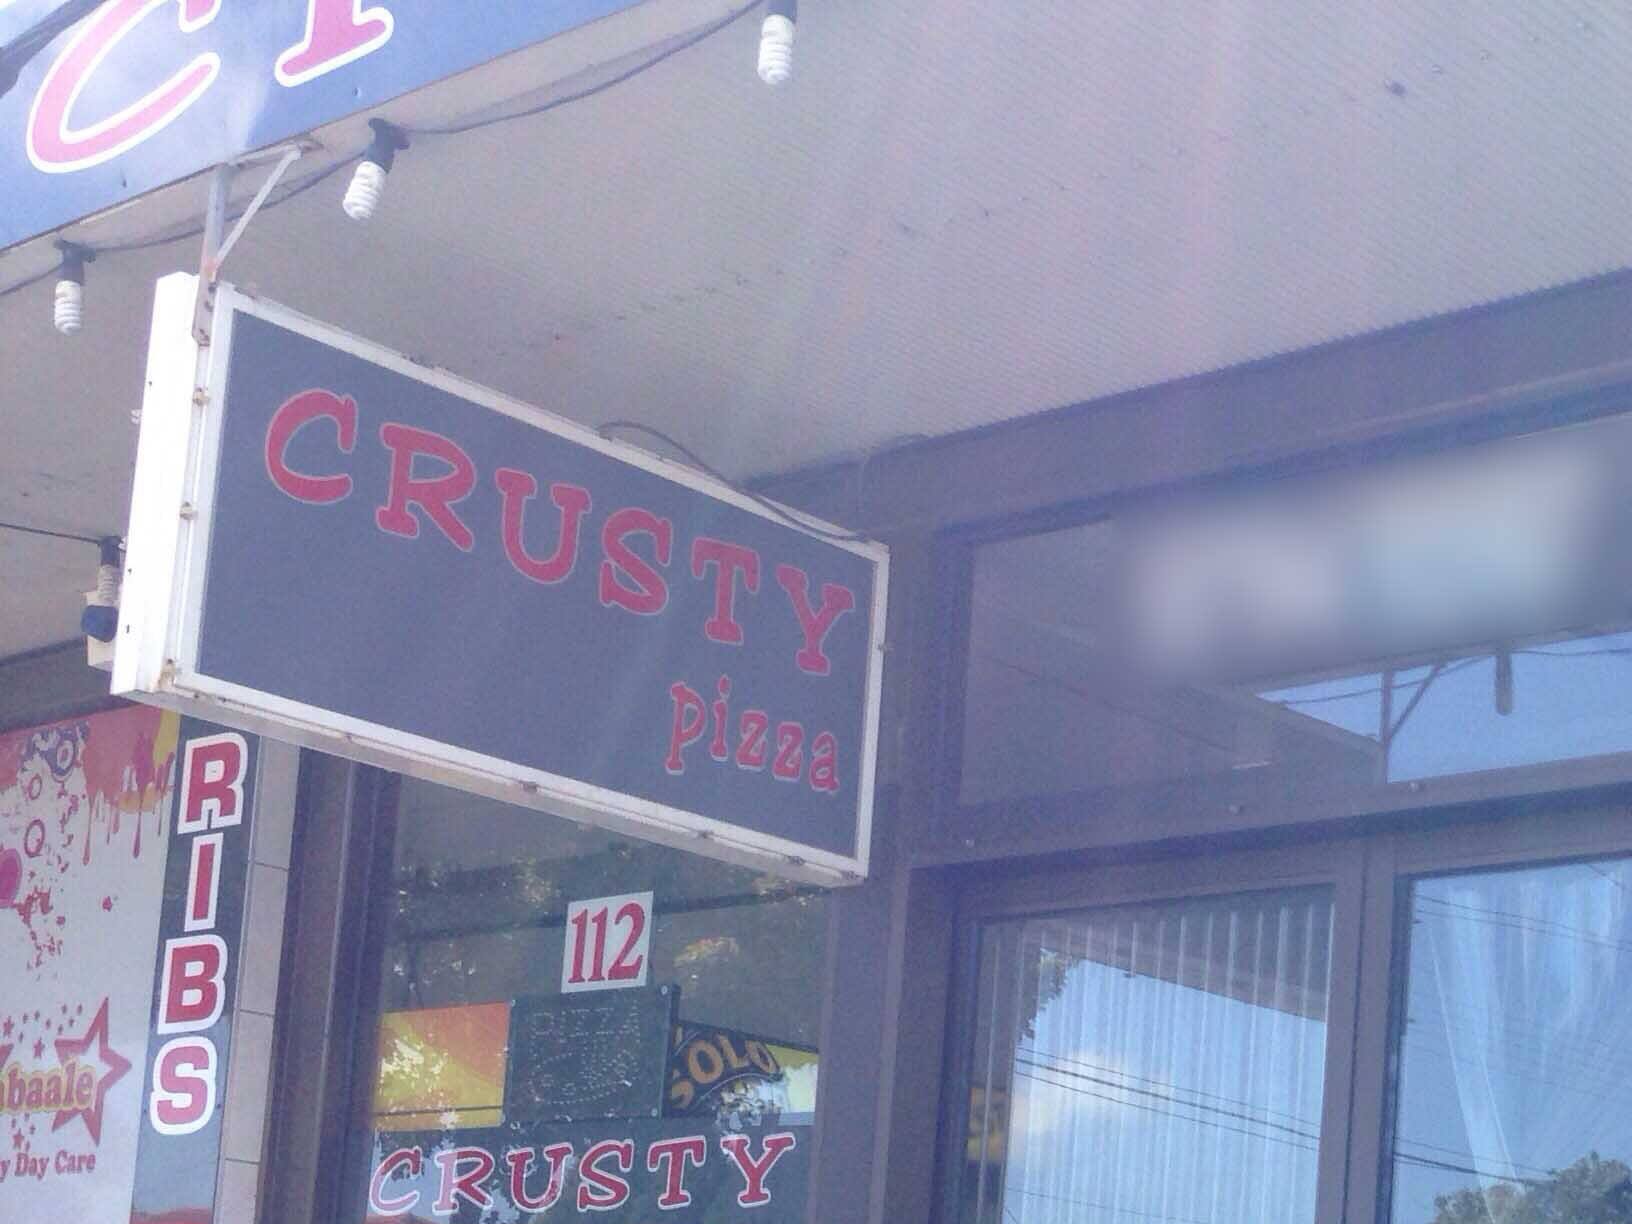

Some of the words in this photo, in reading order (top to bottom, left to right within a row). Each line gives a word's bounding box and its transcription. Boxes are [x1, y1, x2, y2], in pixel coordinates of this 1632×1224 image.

[264, 389, 855, 675] CRUSTY
[664, 673, 840, 793] pizza
[150, 732, 249, 1136] RIBS
[568, 902, 646, 984] 112
[15, 1152, 50, 1180] Day
[55, 1149, 97, 1175] Care
[368, 1131, 794, 1216] CRUSTY
